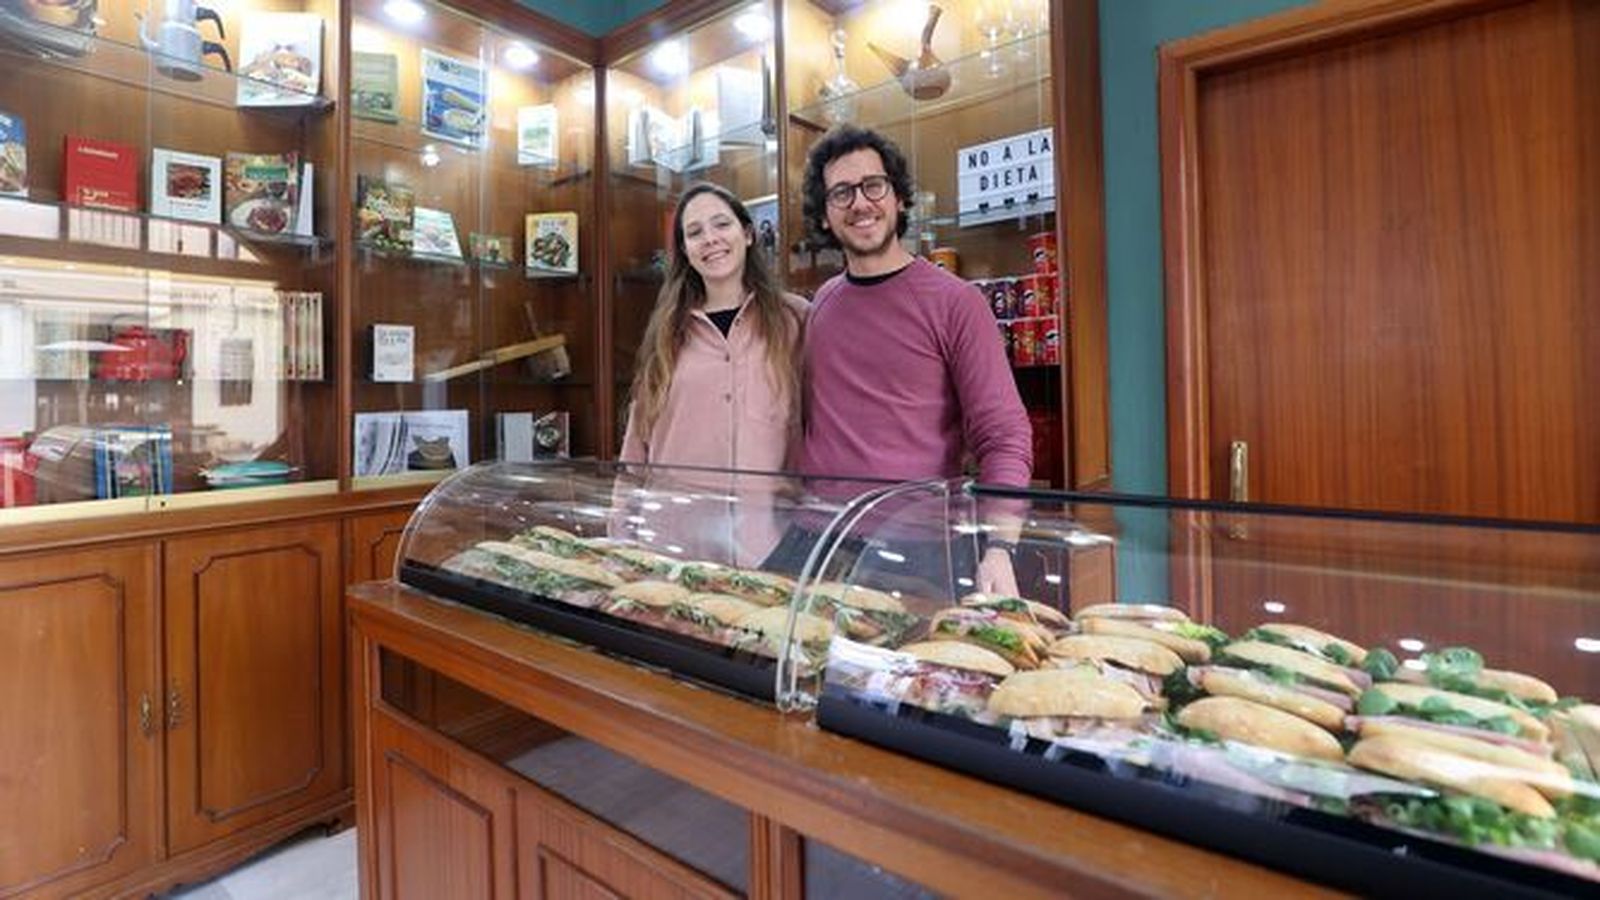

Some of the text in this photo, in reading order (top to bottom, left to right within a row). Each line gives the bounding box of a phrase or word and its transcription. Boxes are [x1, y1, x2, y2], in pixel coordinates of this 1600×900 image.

[968, 138, 1051, 168] NO A LA
[980, 165, 1037, 191] DIETA
